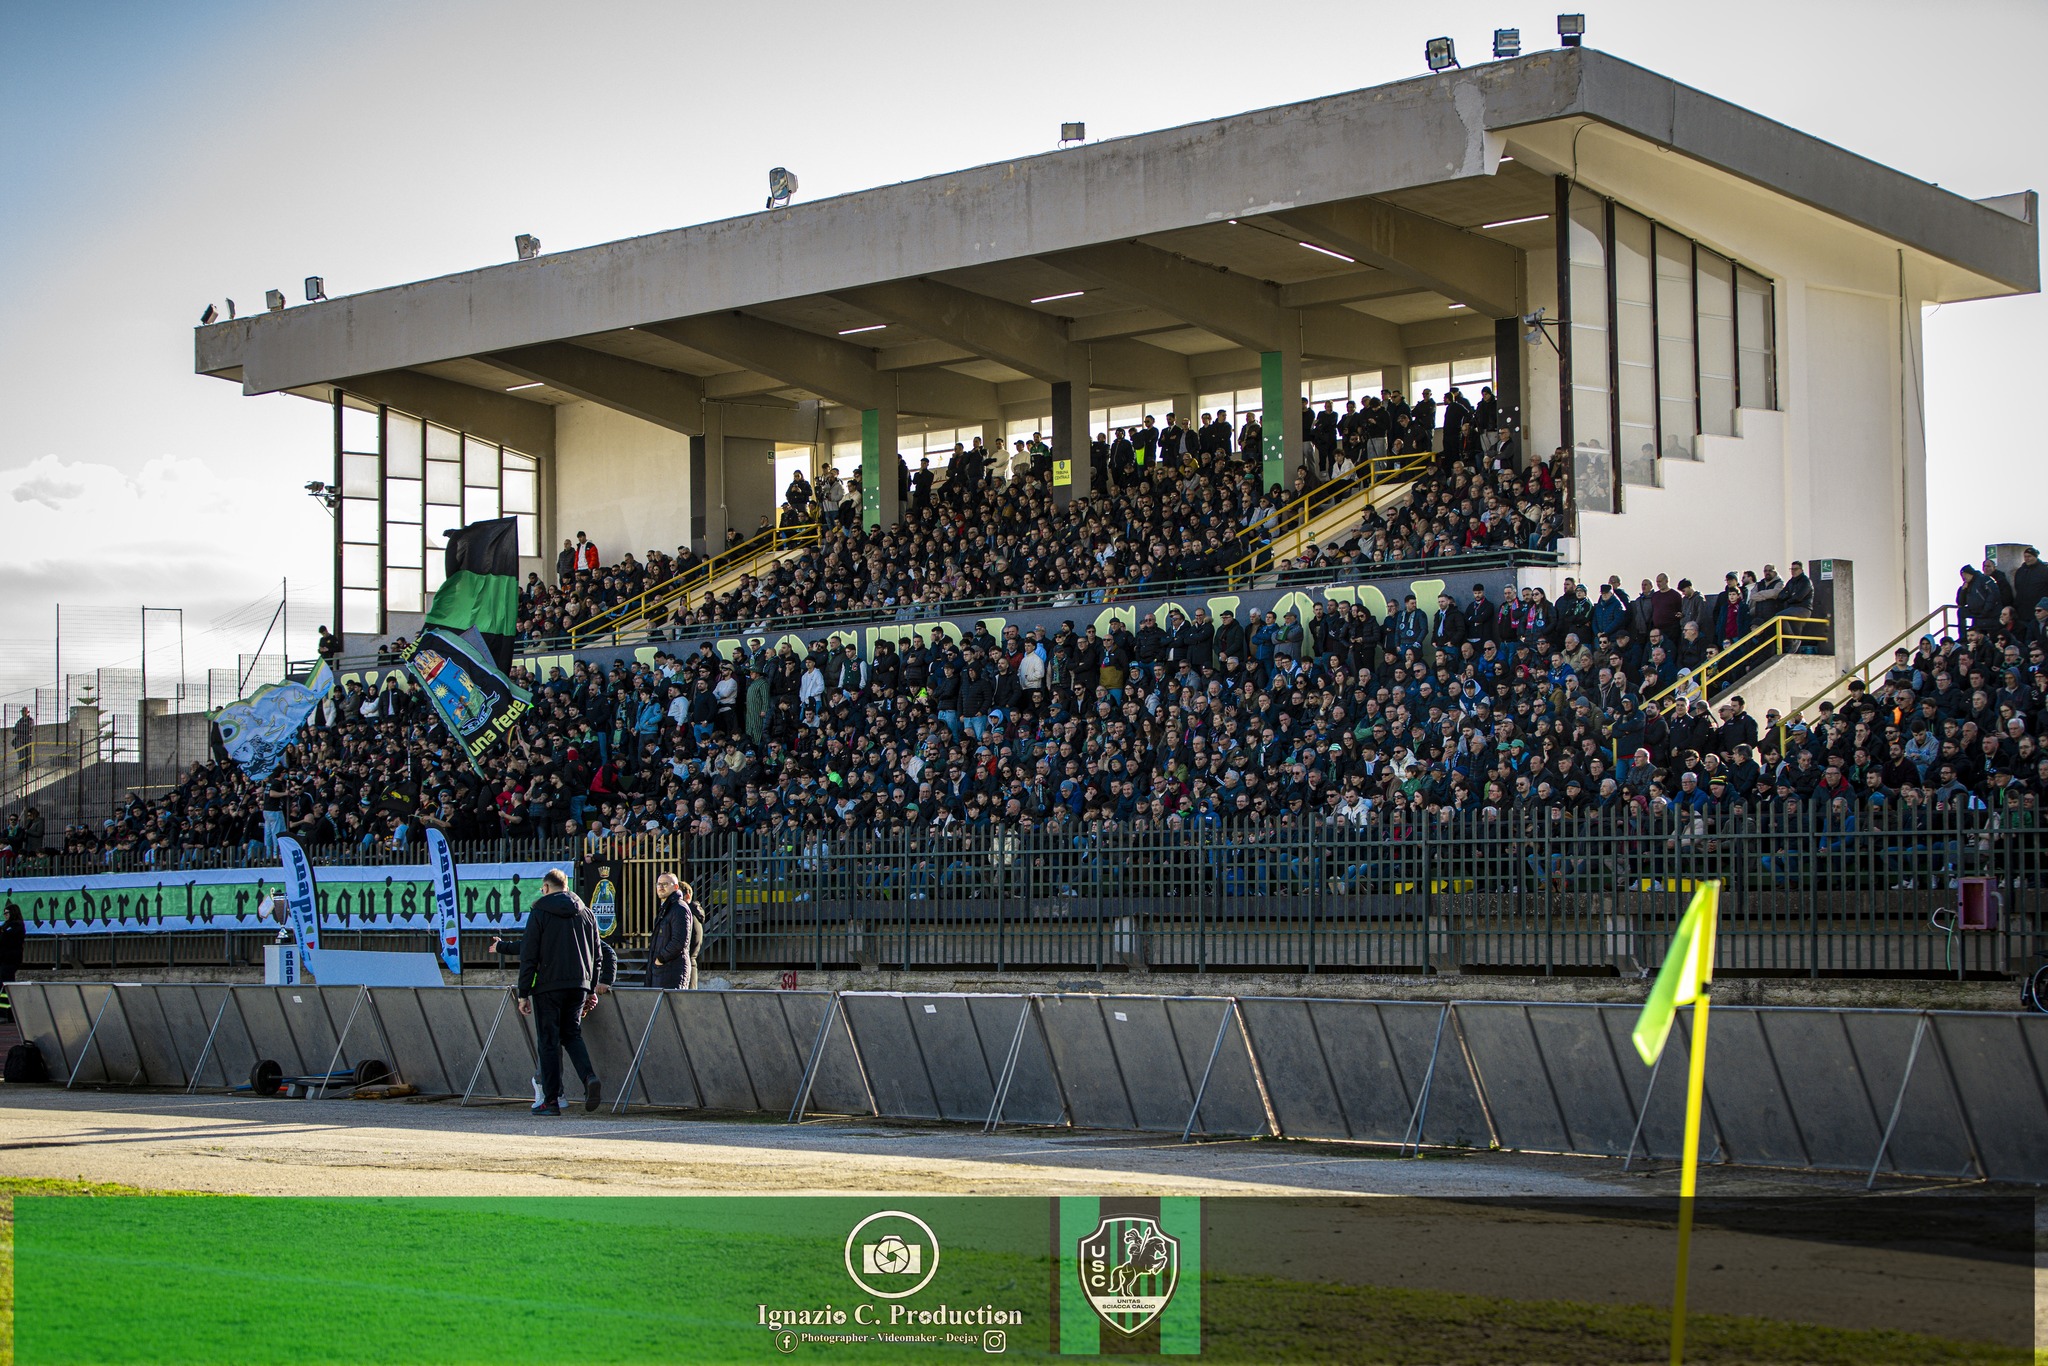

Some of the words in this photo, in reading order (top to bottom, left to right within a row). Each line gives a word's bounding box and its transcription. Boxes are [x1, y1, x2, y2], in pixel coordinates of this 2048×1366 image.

[468, 728, 497, 757] una
[491, 699, 526, 733] fede
[32, 881, 164, 930] crederai
[184, 879, 215, 925] la
[235, 873, 522, 929] rinquistrai
[592, 905, 615, 914] SCIACC
